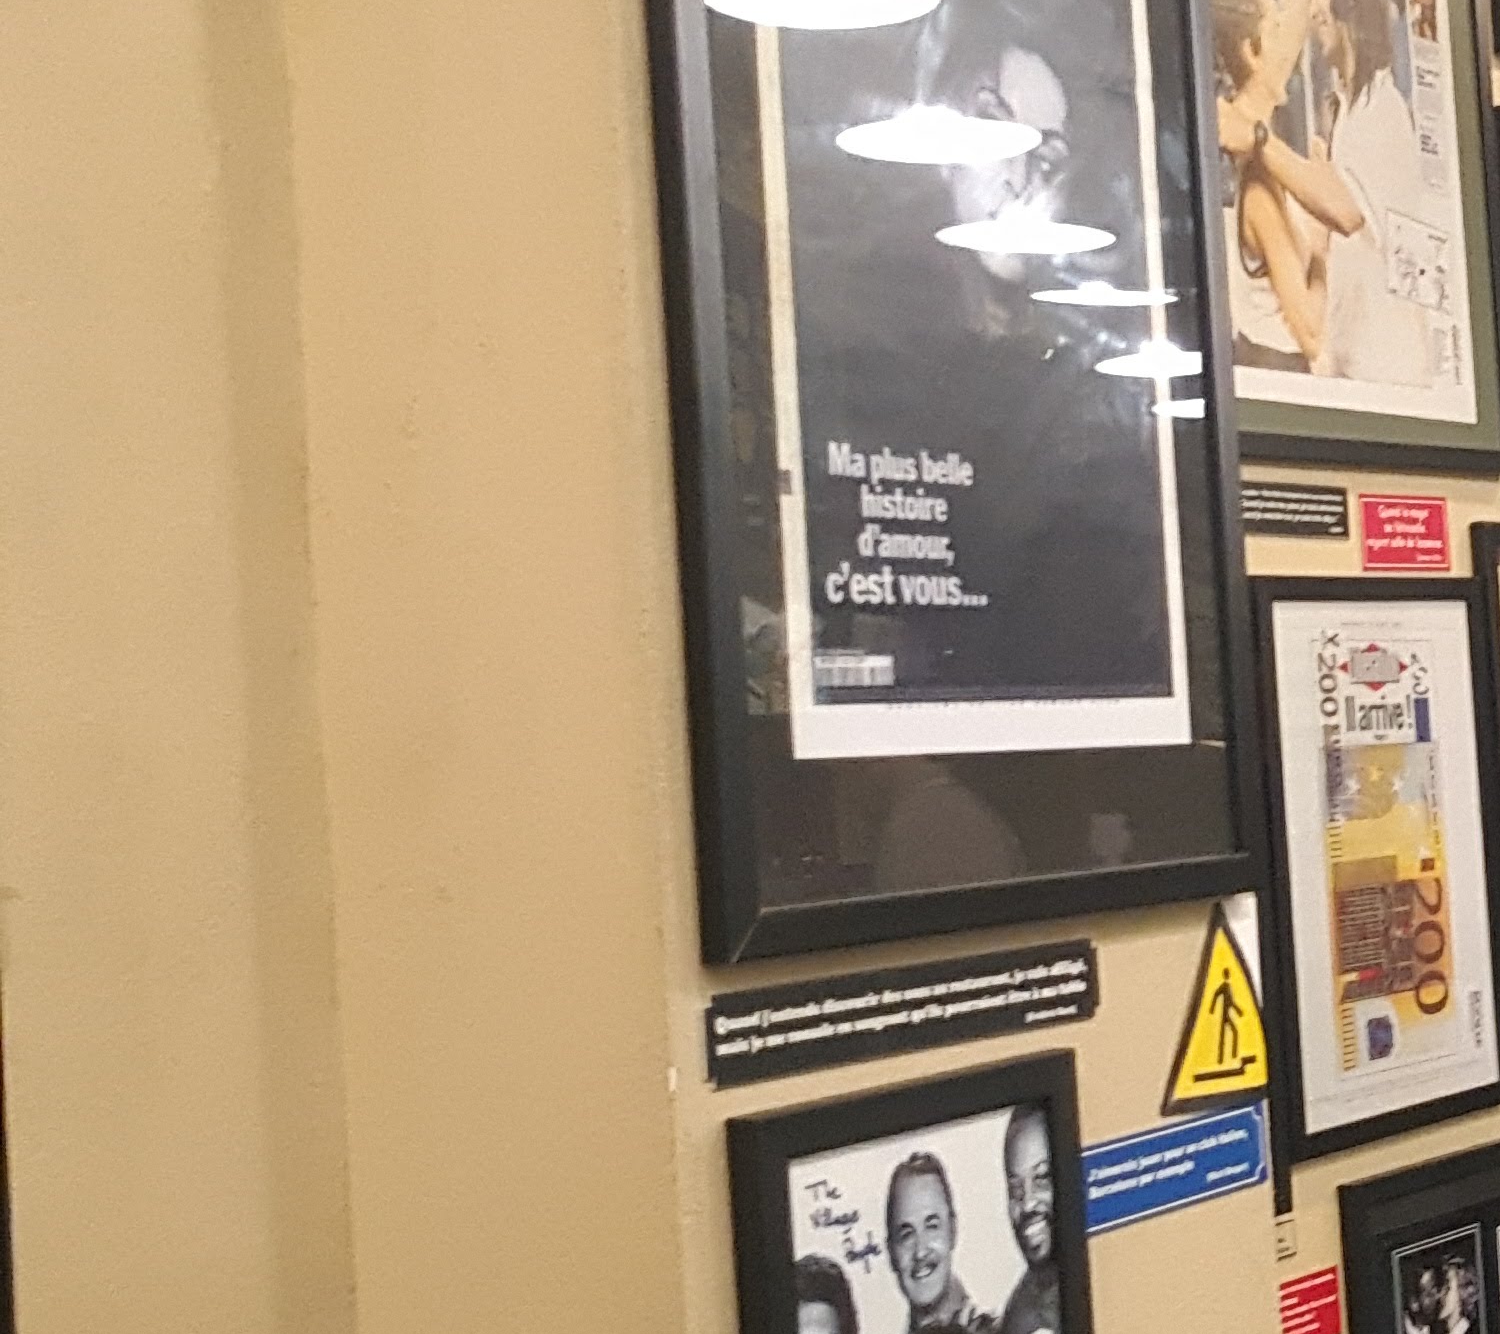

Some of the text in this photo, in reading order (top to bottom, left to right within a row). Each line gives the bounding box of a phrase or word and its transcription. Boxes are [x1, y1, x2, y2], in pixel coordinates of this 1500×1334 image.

[827, 440, 974, 486] Ma plus belle
[860, 483, 948, 522] histoire
[825, 561, 896, 605] c'est
[1413, 877, 1449, 1014] 200
